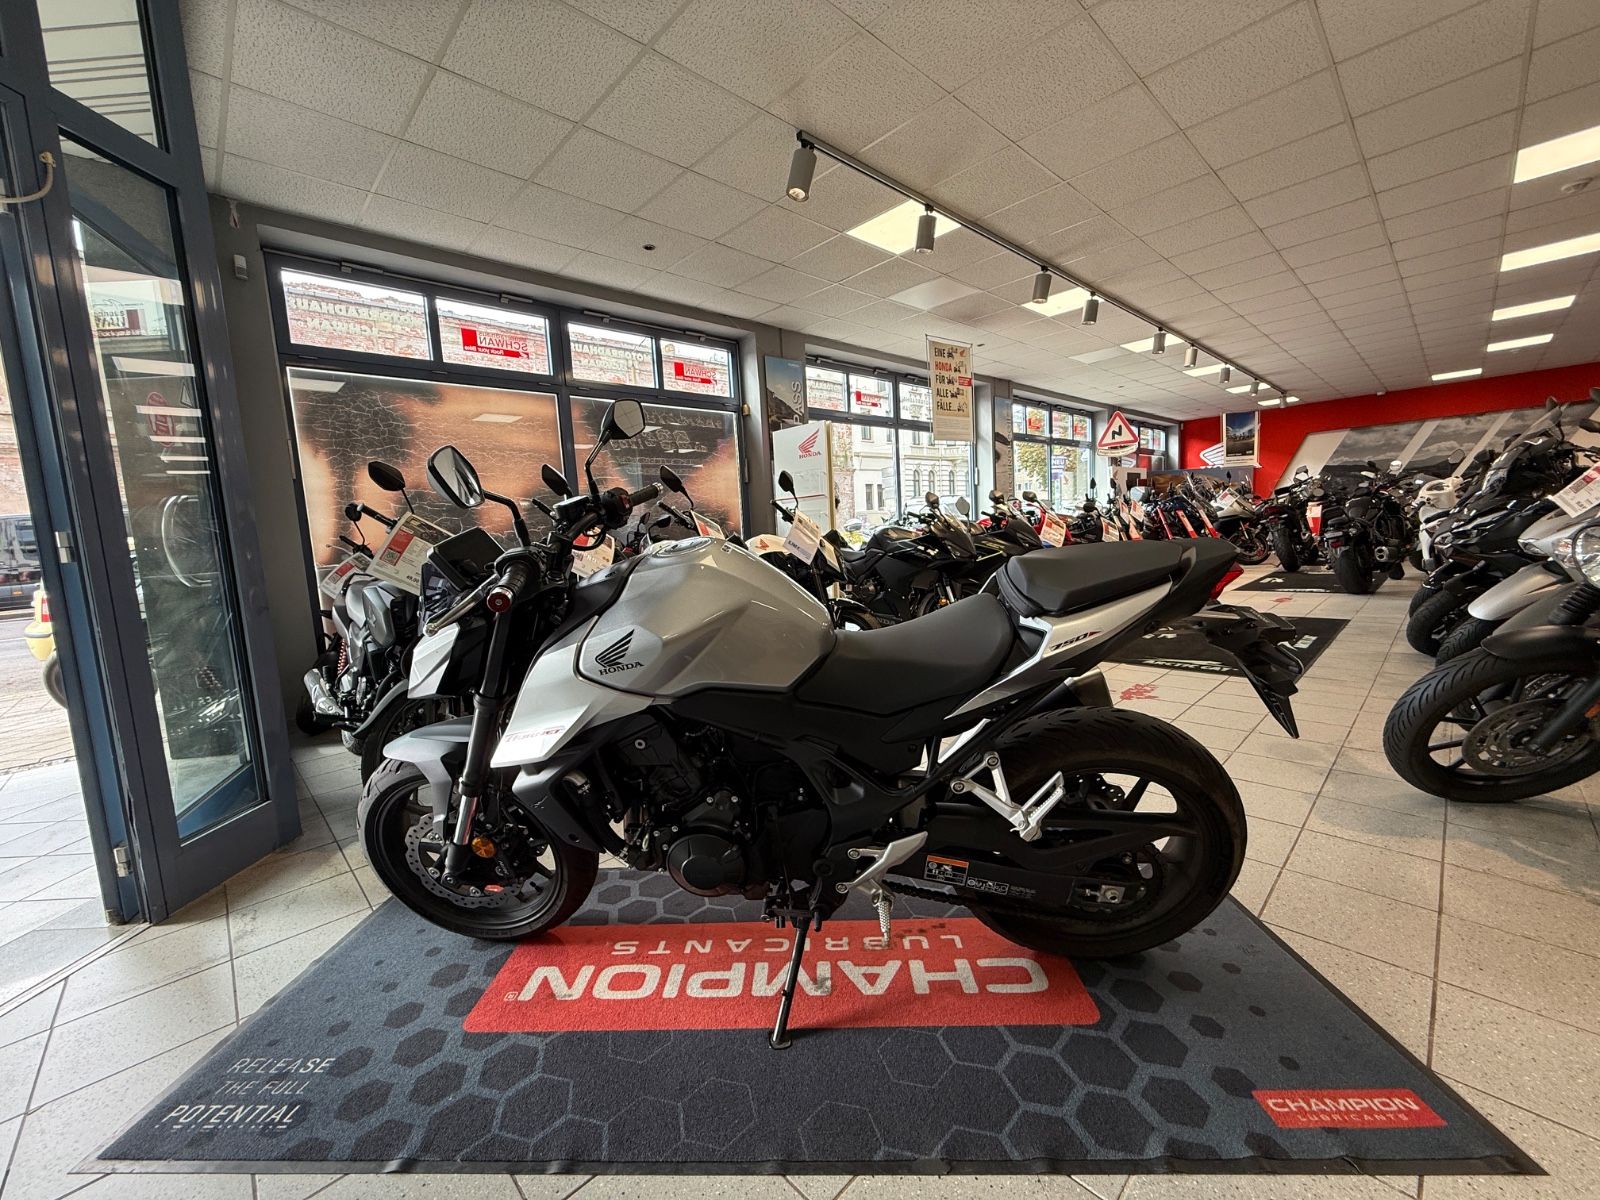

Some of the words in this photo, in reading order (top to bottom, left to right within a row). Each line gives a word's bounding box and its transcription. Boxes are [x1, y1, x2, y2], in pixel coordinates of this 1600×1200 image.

[934, 347, 946, 358] EINE
[934, 361, 952, 372] HONDA
[935, 372, 945, 384] FÜR
[936, 387, 948, 398] ALLE
[791, 381, 804, 425] PASS
[798, 451, 822, 459] HONDA
[1050, 631, 1089, 650] 750
[598, 661, 645, 676] HONDA
[611, 935, 963, 955] LUBRICANTS
[517, 958, 1050, 1002] CHAMPION
[226, 1057, 336, 1074] RELEASE
[215, 1080, 259, 1095] THE
[257, 1080, 311, 1095] FULL
[1266, 1097, 1420, 1112] CHAMPION
[161, 1104, 301, 1123] POTENTIAL
[1296, 1113, 1409, 1122] LUBRICANTS
